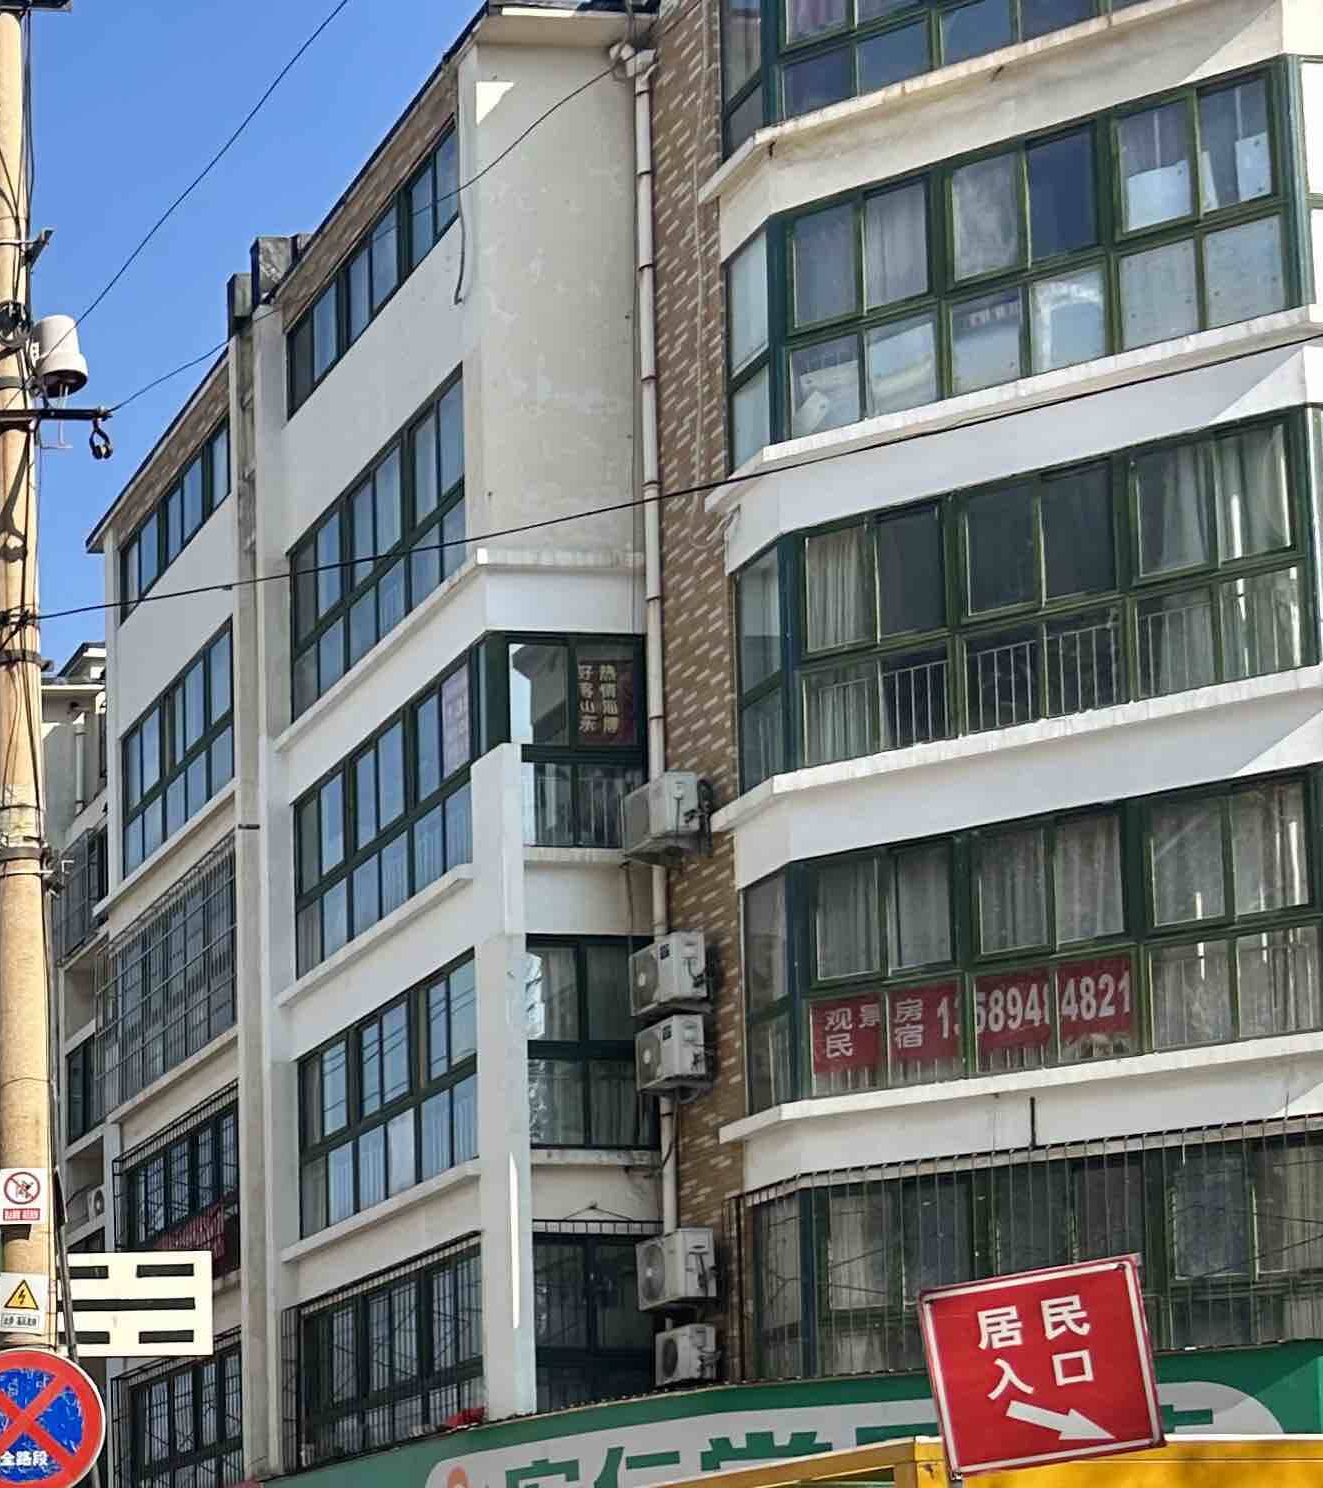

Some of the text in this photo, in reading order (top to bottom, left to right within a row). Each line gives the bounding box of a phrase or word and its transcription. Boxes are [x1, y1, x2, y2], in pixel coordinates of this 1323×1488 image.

[826, 1025, 924, 1058] 民宿
[976, 1295, 1091, 1350] 居民
[986, 1350, 1094, 1401] 入口
[0, 1450, 48, 1466] 全路段
